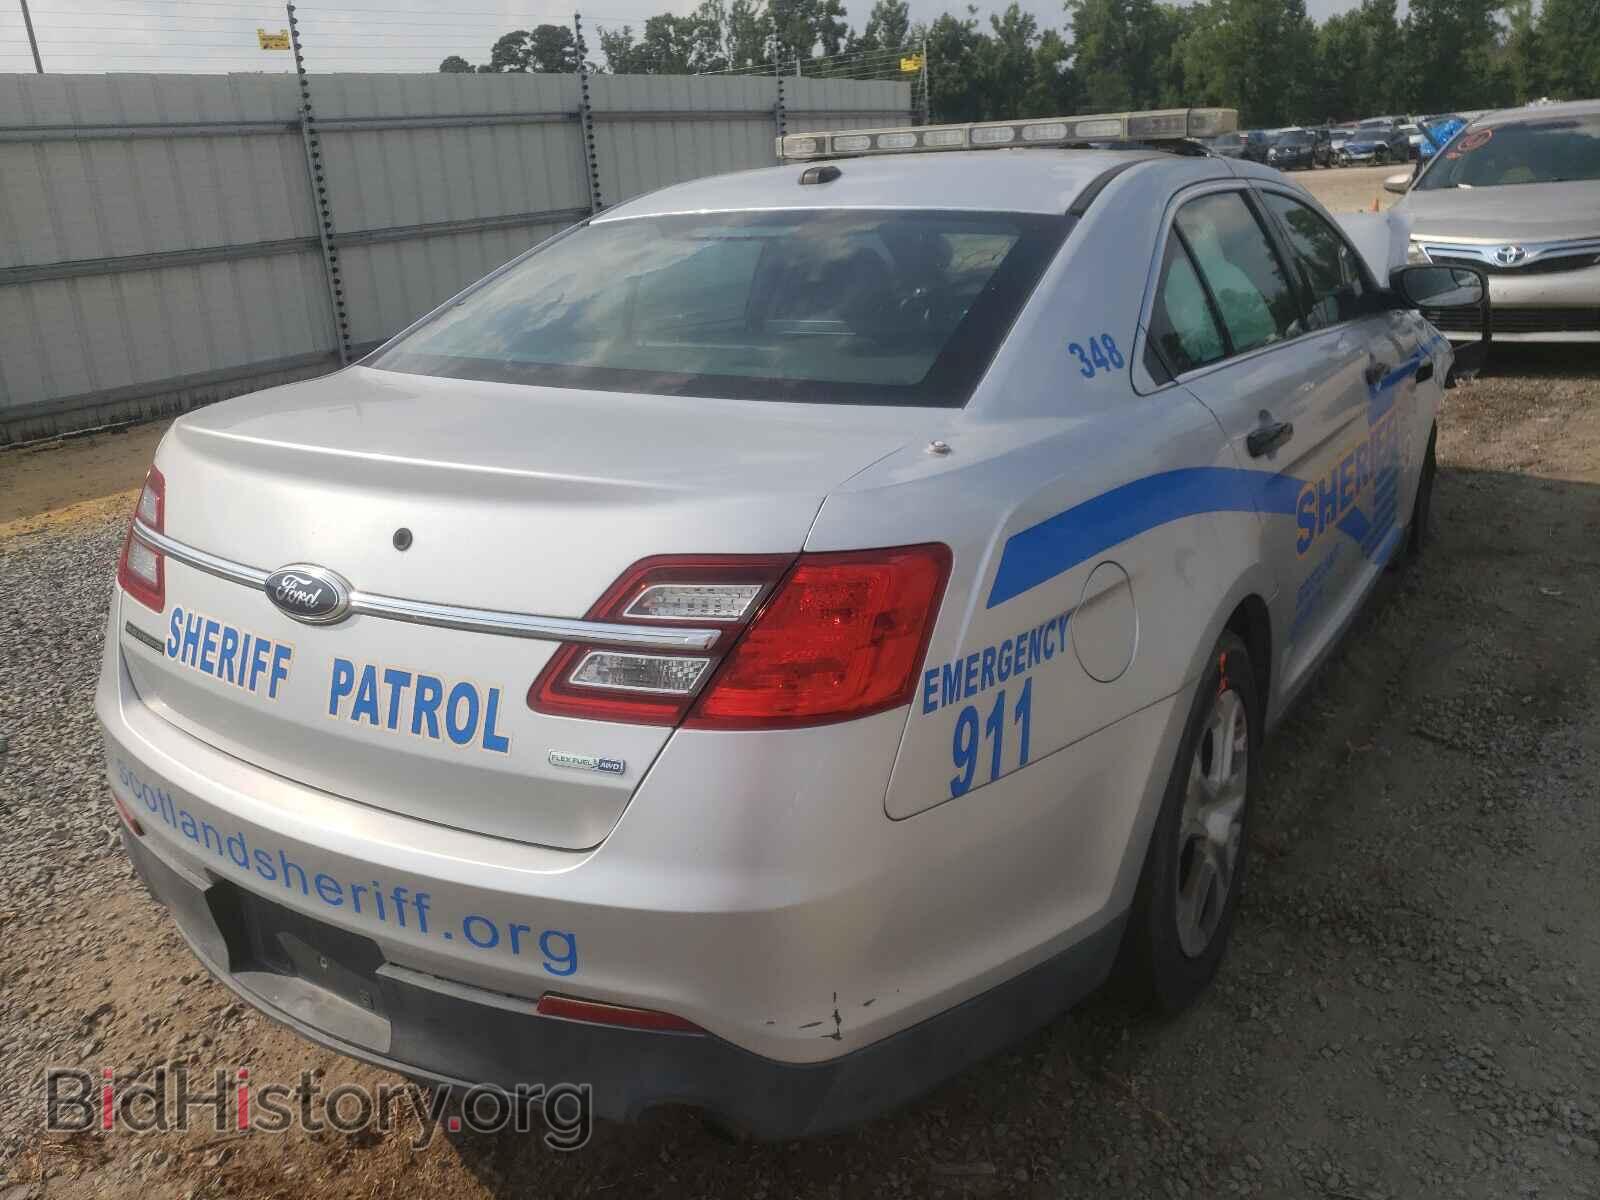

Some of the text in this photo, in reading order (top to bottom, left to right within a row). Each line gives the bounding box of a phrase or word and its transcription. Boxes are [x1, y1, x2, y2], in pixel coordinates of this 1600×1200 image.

[1068, 333, 1125, 378] 348
[275, 574, 322, 609] Ford
[166, 606, 511, 754] SHERIFF PATROL
[922, 613, 1072, 715] EMERGENCY
[950, 676, 1033, 799] 911
